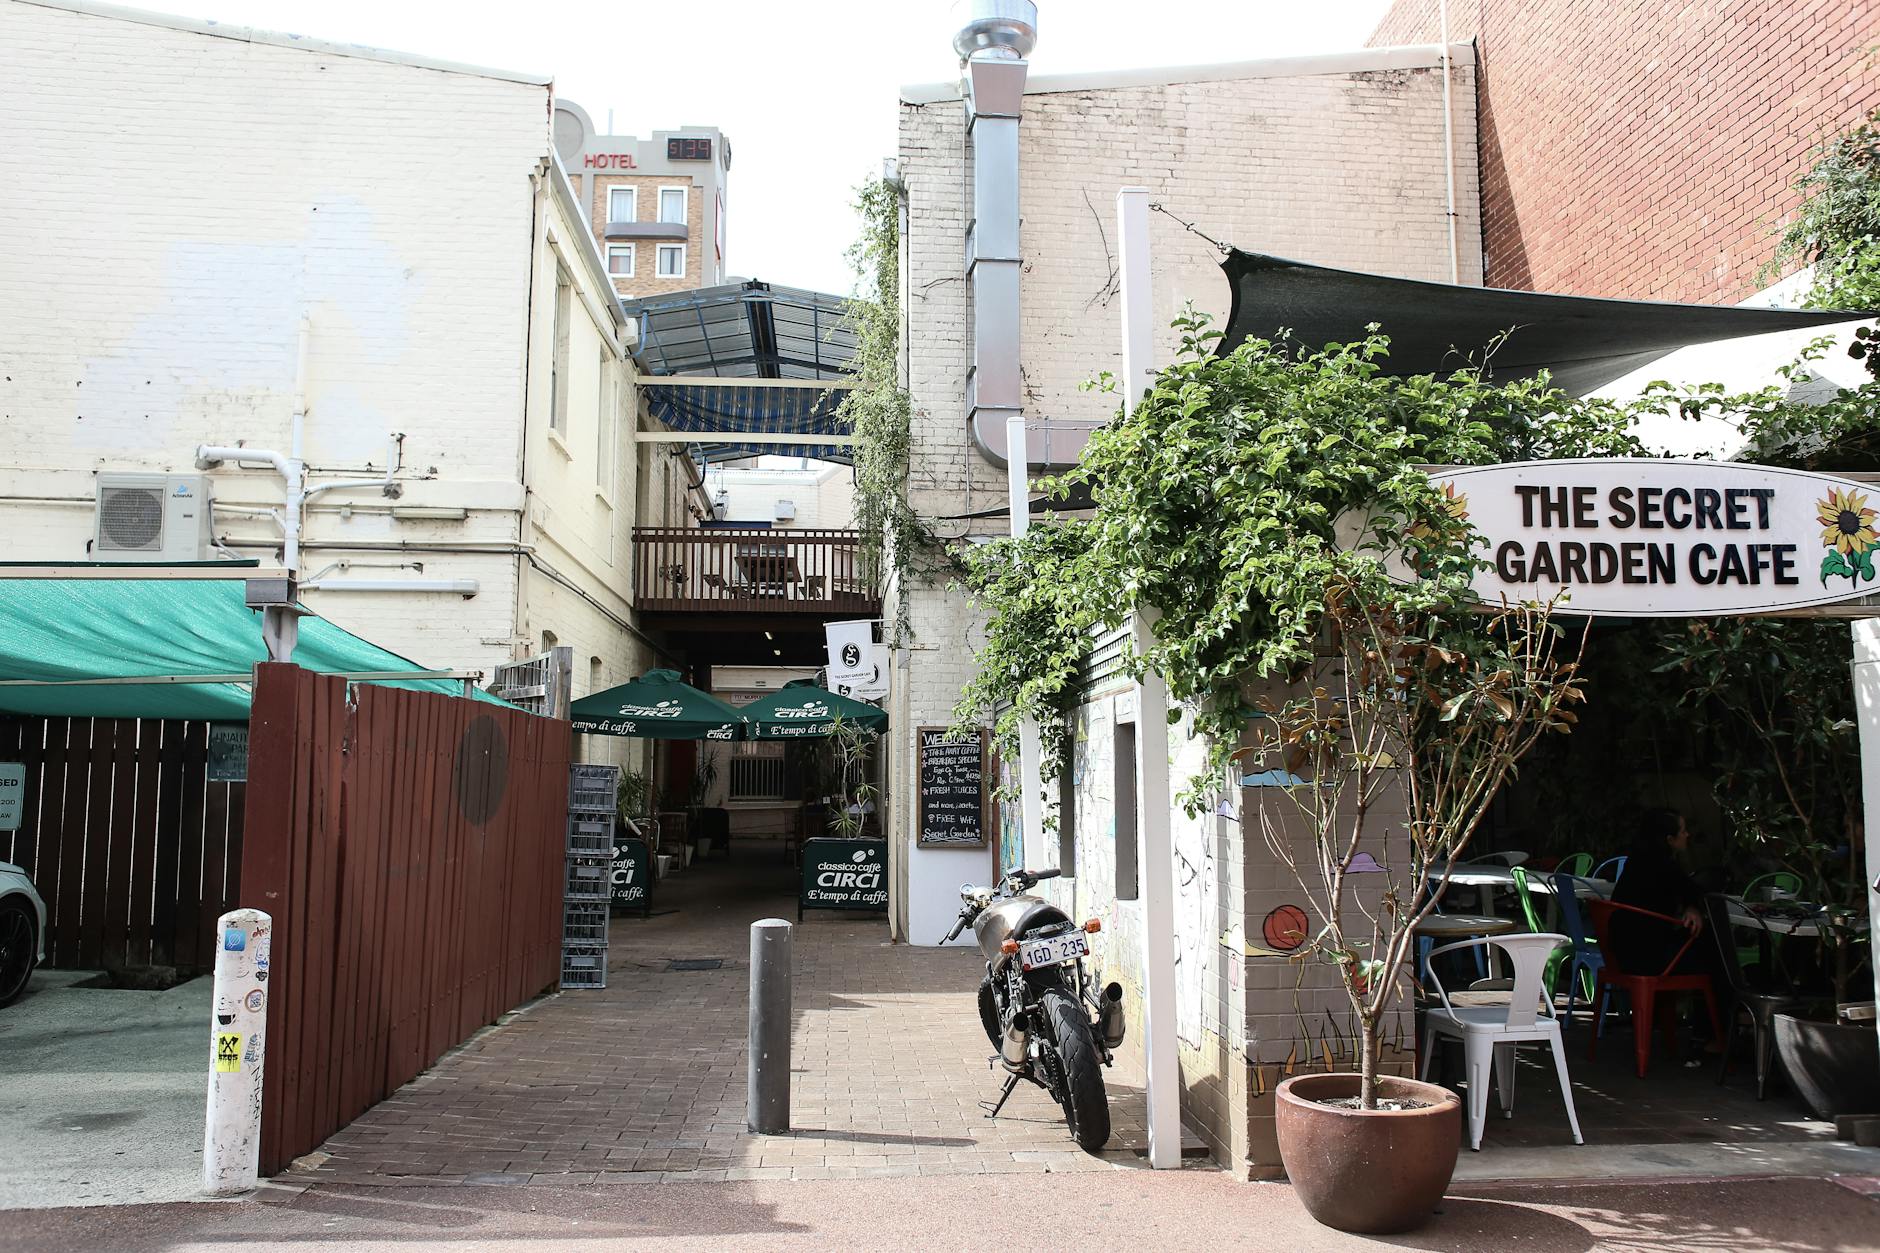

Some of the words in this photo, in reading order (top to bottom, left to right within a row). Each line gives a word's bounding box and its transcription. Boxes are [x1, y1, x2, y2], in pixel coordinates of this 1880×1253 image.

[584, 153, 637, 169] HOTEL
[1514, 485, 1599, 529] THE
[1608, 486, 1775, 530] SECRET
[1496, 540, 1677, 585] GARDEN
[1689, 542, 1800, 586] CAFE
[619, 708, 681, 717] CIRCI
[599, 720, 609, 731] di
[808, 724, 817, 733] di
[930, 786, 950, 795] FRESH
[953, 786, 978, 794] JUICES
[936, 813, 956, 823] FREE
[924, 827, 948, 838] Secret
[950, 826, 976, 838] Garden
[818, 862, 857, 871] classico
[857, 863, 881, 873] caffè
[817, 872, 880, 888] CIRCI
[850, 890, 861, 901] di
